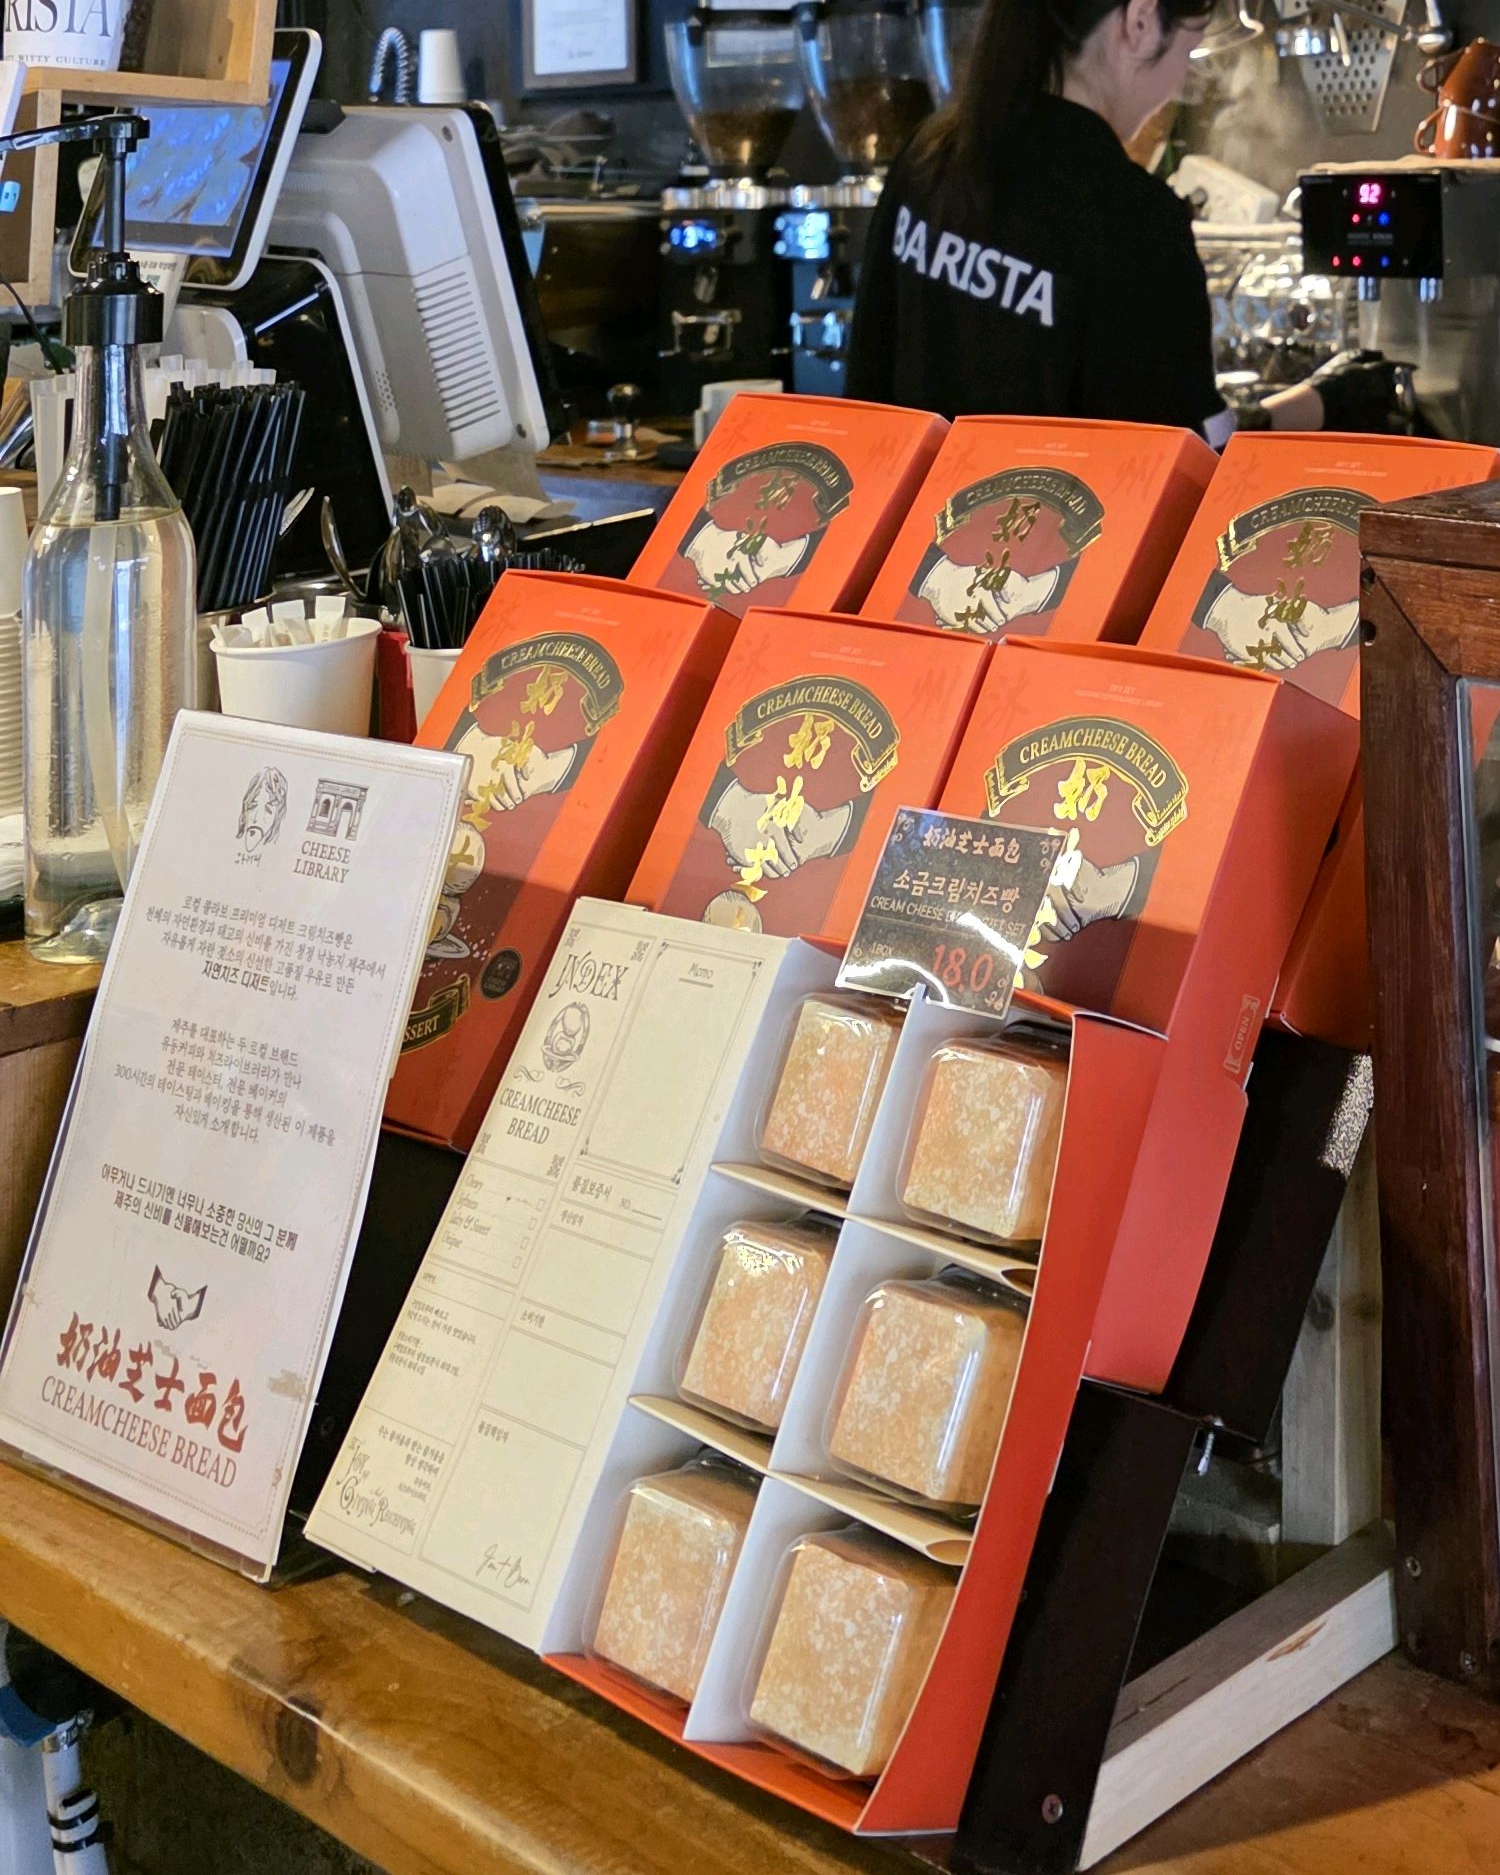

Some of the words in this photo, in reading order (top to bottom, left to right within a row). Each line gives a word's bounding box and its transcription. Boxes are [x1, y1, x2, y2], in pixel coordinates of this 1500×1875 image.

[56, 55, 107, 67] CULTURE
[893, 204, 1056, 328] BARISTA
[757, 685, 852, 720] CREAMCHEESE
[850, 696, 883, 741] BREAD
[1019, 728, 1130, 764] CREAMCHEESE
[1127, 739, 1167, 789] BREAD
[301, 841, 351, 863] CHEESE
[922, 824, 1021, 864] 奶油芝士面包
[294, 859, 348, 882] LIBRARY
[893, 868, 1022, 914] 소금크림치즈빵
[230, 907, 266, 928] 프리미엄
[267, 915, 296, 935] 디저트
[870, 895, 906, 912] CREAM
[906, 904, 945, 922] CHEESE
[1006, 920, 1026, 936] SET
[196, 940, 215, 959] 자란
[245, 952, 273, 973] 신선한
[274, 959, 303, 981] 고품질
[304, 967, 333, 988] 우유로
[334, 974, 355, 994] 만든
[245, 930, 273, 950] 신비를
[274, 937, 293, 955] 가진
[346, 954, 386, 978] 제주에서
[548, 949, 630, 1002] INDEX
[932, 943, 995, 993] 18.0
[201, 961, 239, 984] 자연치즈
[240, 971, 299, 1000] 디저트입니다.
[170, 1017, 197, 1037] 제주를
[269, 1045, 300, 1066] 브랜드
[1234, 1016, 1250, 1051] OPEN
[166, 1059, 185, 1077] 전문
[226, 1077, 245, 1095] 전문
[498, 1087, 582, 1126] CREAMCHEESE
[506, 1118, 550, 1144] BREAD
[99, 1163, 135, 1192] 아무거나
[176, 1189, 205, 1216] 너무나
[205, 1199, 236, 1227] 소중한
[236, 1210, 264, 1236] 당신의
[263, 1219, 275, 1241] 그
[112, 1190, 141, 1216] 제주의
[56, 1311, 248, 1453] 奶油芝士面包
[39, 1373, 172, 1458] CREAMCHEESE
[171, 1431, 239, 1488] BREAD
